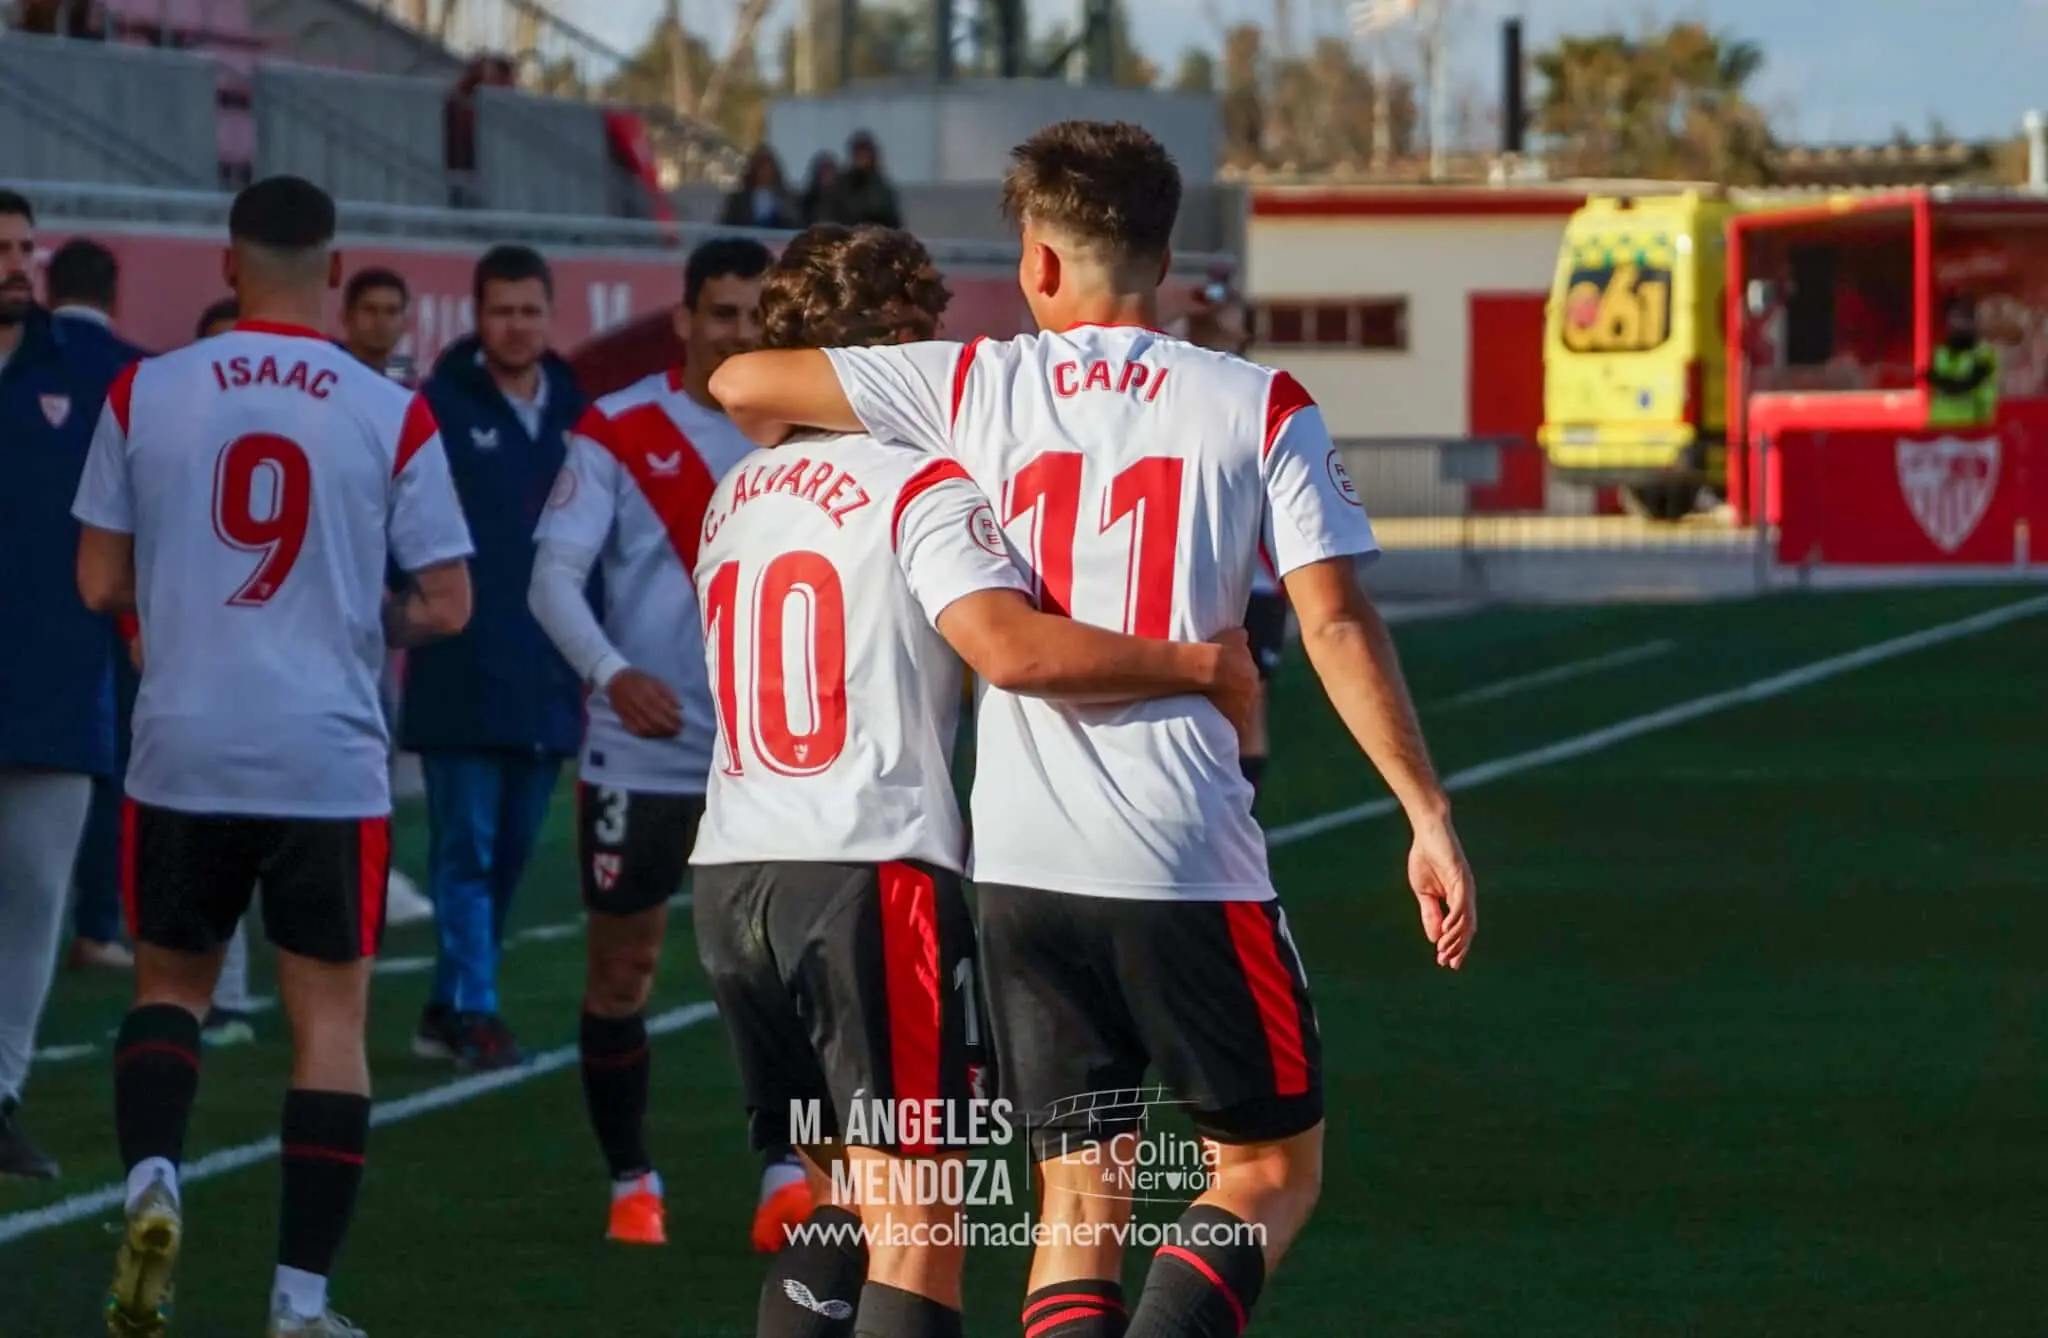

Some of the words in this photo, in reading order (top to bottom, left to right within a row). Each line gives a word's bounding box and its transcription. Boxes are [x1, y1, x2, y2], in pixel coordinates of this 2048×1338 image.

[212, 355, 338, 399] ISAAC
[1054, 359, 1169, 402] CAPI
[211, 432, 311, 607] 9
[703, 509, 726, 545] C.
[1000, 451, 1184, 640] 11
[704, 550, 848, 778] 10
[595, 785, 628, 845] 3
